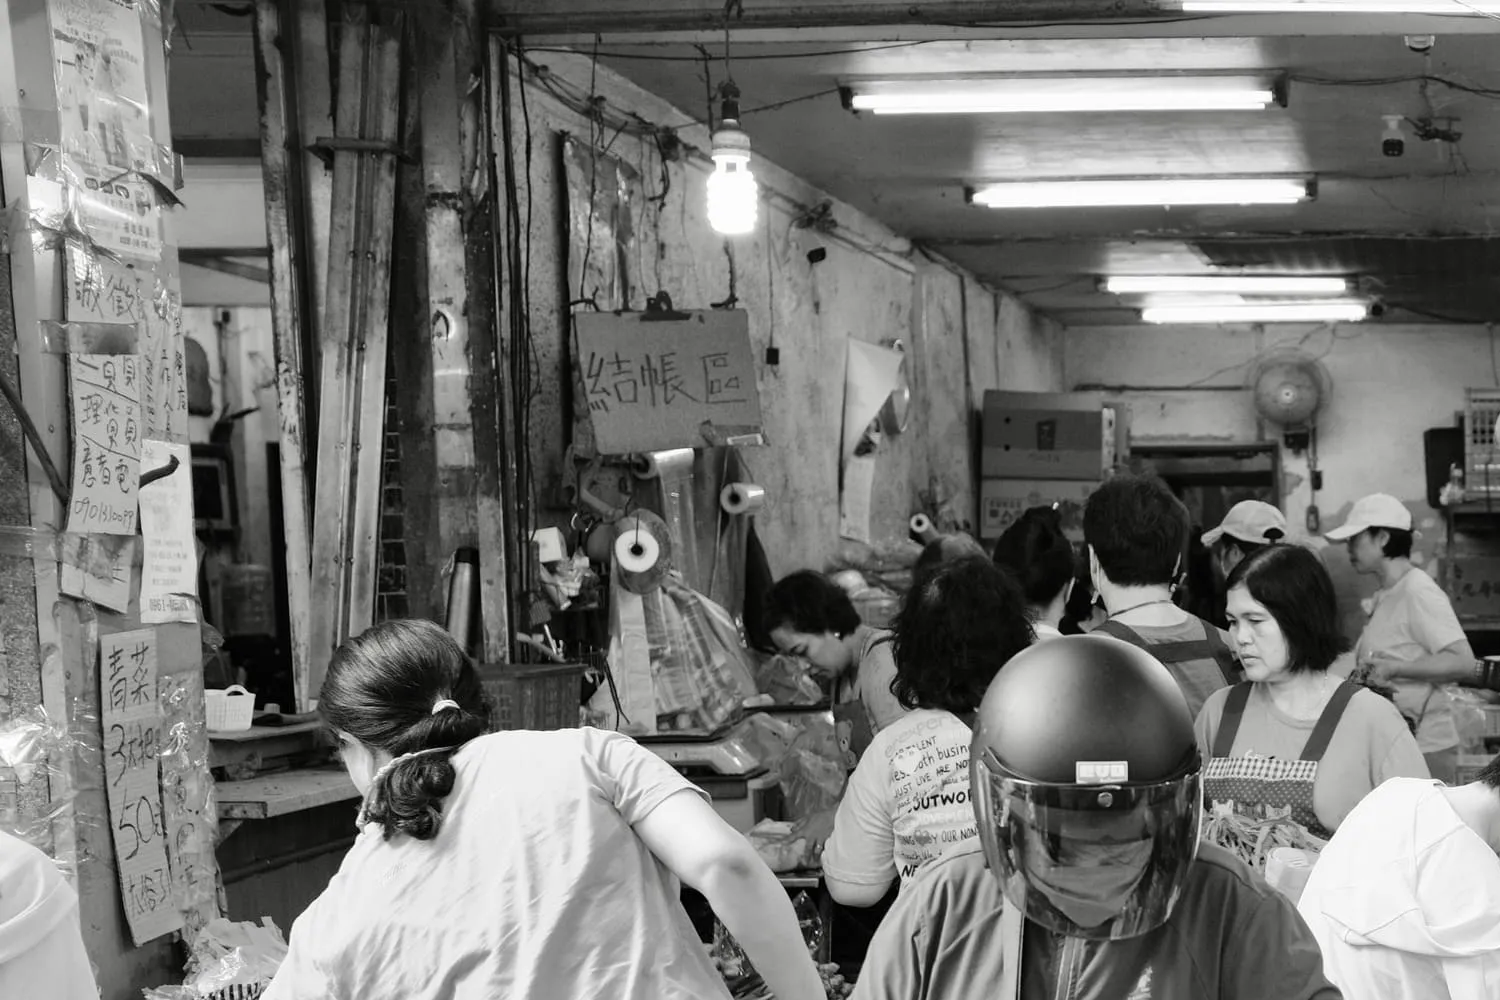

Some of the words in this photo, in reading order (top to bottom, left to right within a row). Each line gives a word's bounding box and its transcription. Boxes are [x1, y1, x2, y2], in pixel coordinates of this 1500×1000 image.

[586, 352, 748, 413] 結帳區
[109, 643, 149, 714] 青菜
[936, 744, 970, 760] busin
[955, 760, 970, 771] NO
